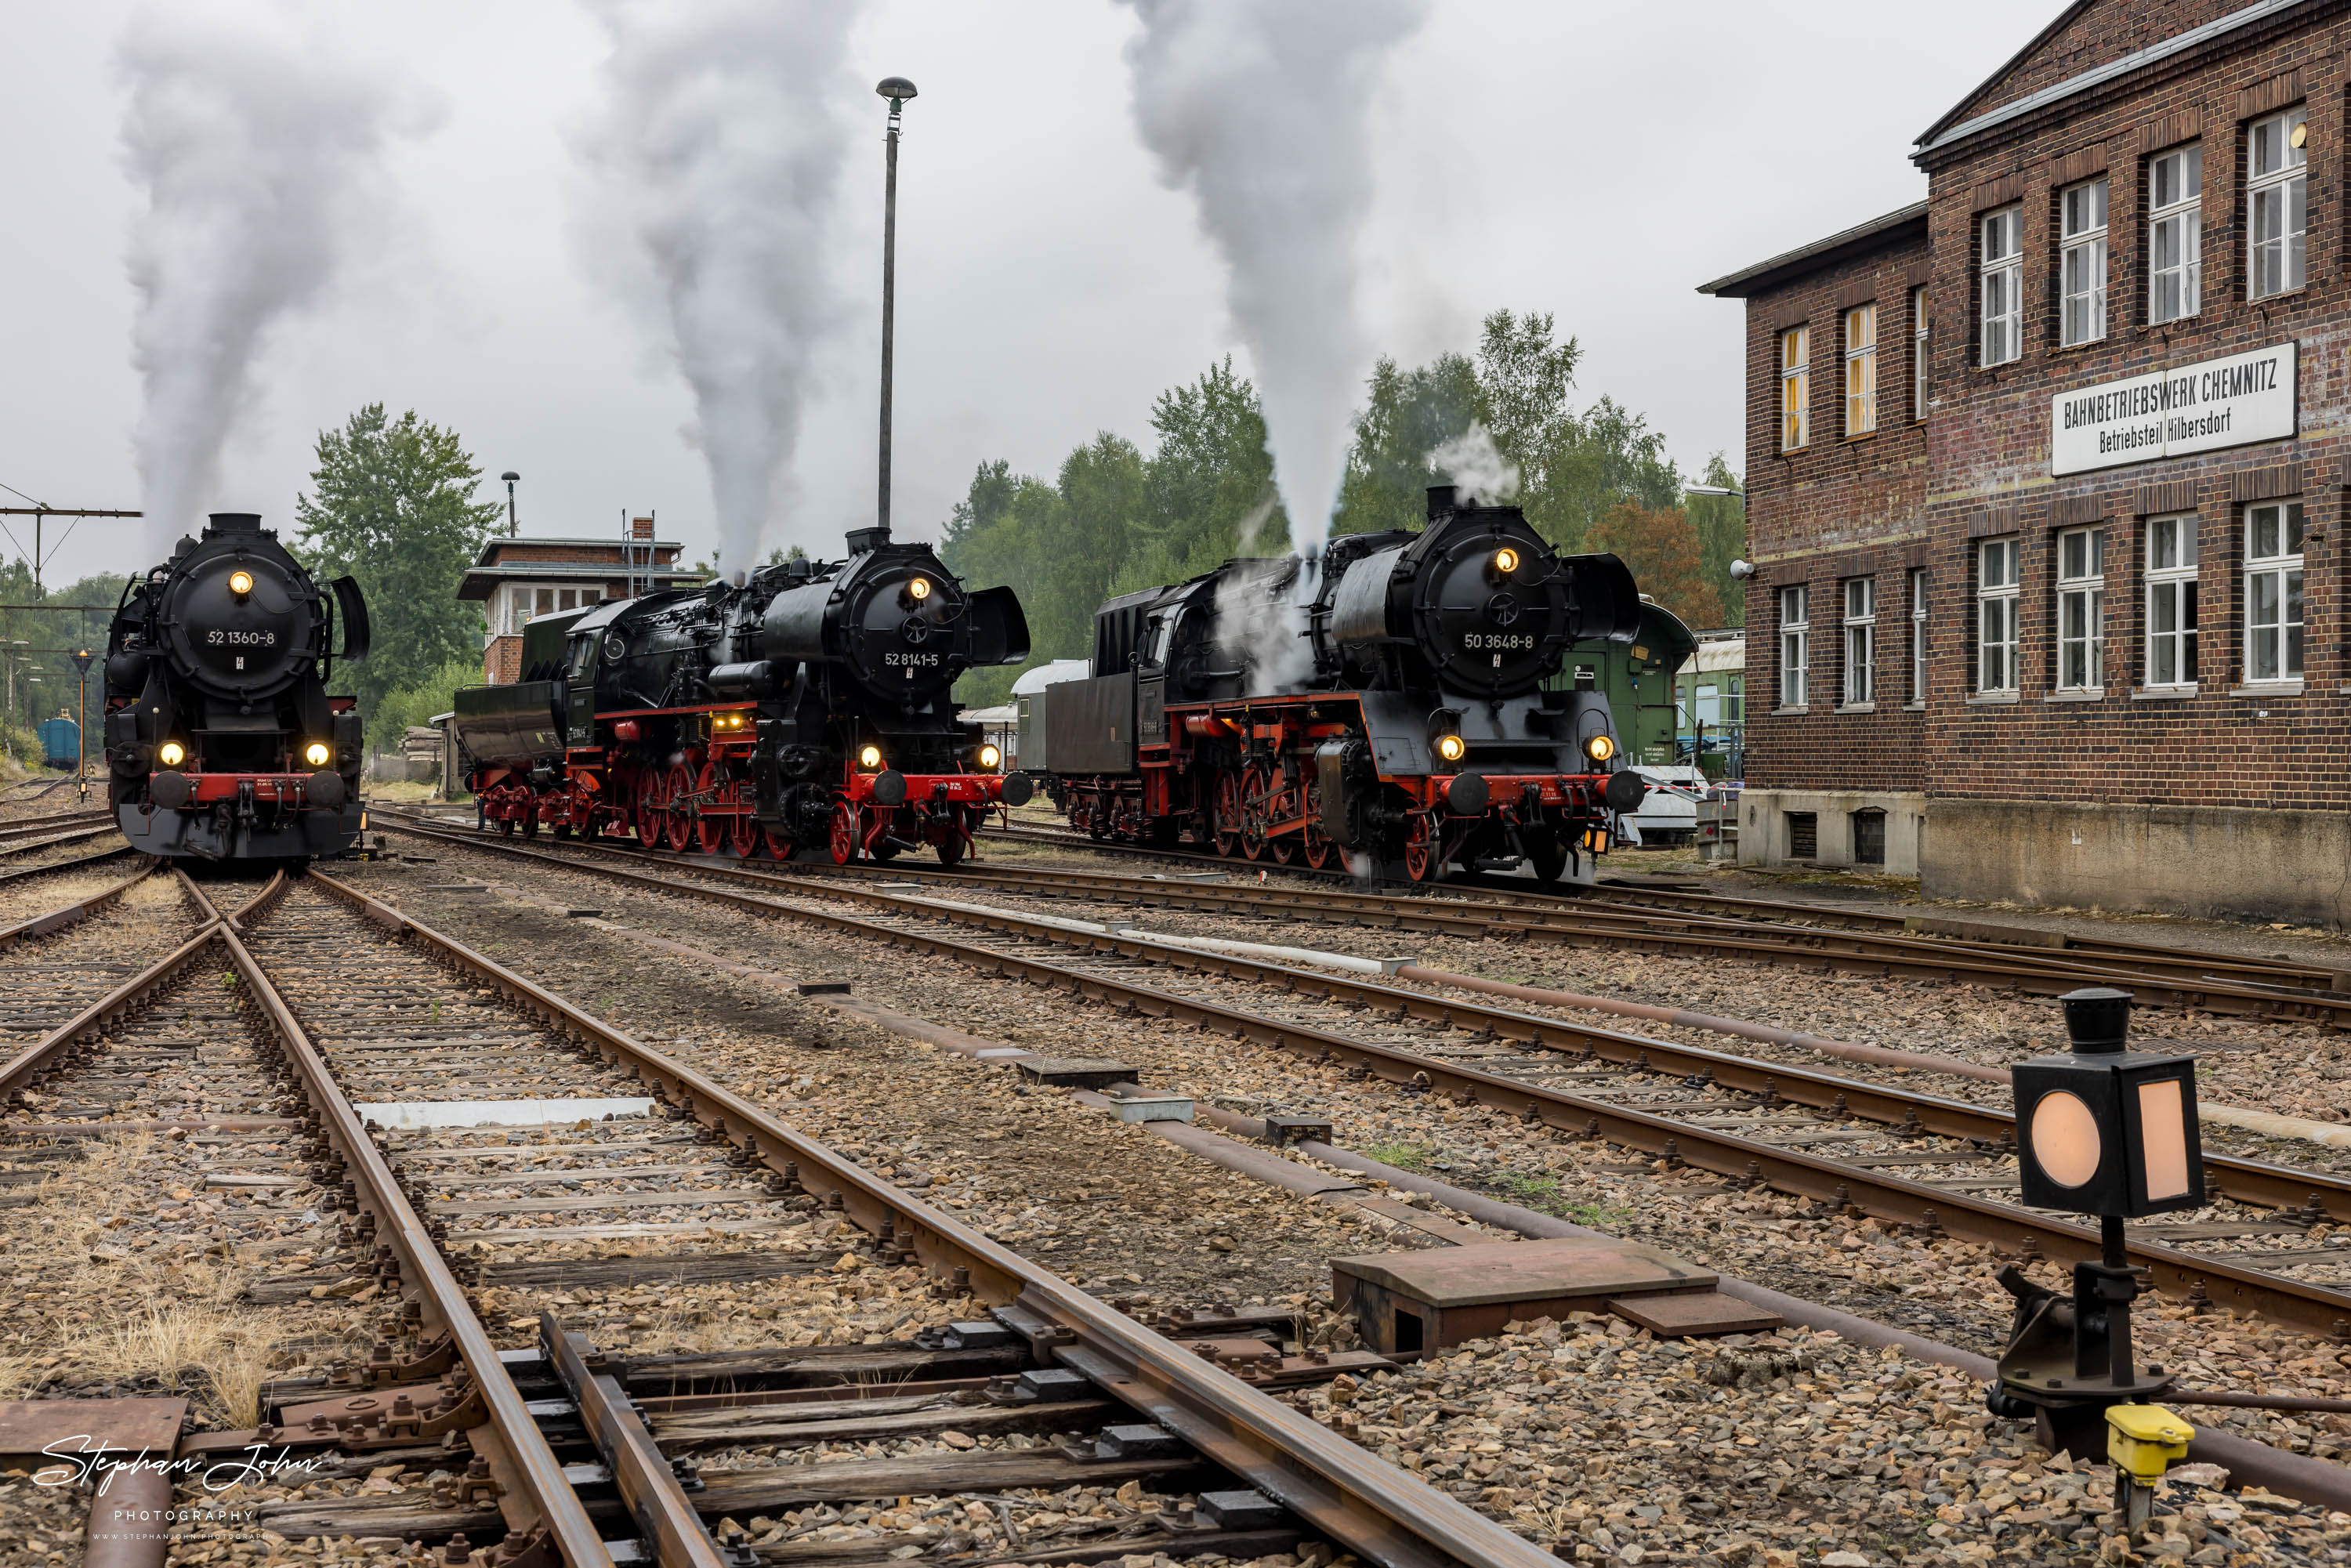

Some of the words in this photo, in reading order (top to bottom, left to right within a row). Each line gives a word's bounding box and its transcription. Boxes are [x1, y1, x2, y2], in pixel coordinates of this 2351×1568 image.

[2064, 375, 2197, 429] BAHNBETRIEBSWERK
[2202, 357, 2277, 402] CHEMNITZ
[2099, 421, 2163, 454] Betriebsteil
[2167, 407, 2231, 442] Hilbersdorf
[207, 631, 224, 643] 52
[227, 632, 275, 644] 1360-8
[1465, 634, 1482, 648] 50
[1485, 635, 1533, 649] 3648-8
[885, 653, 899, 665] 52
[901, 654, 938, 666] 8141-5
